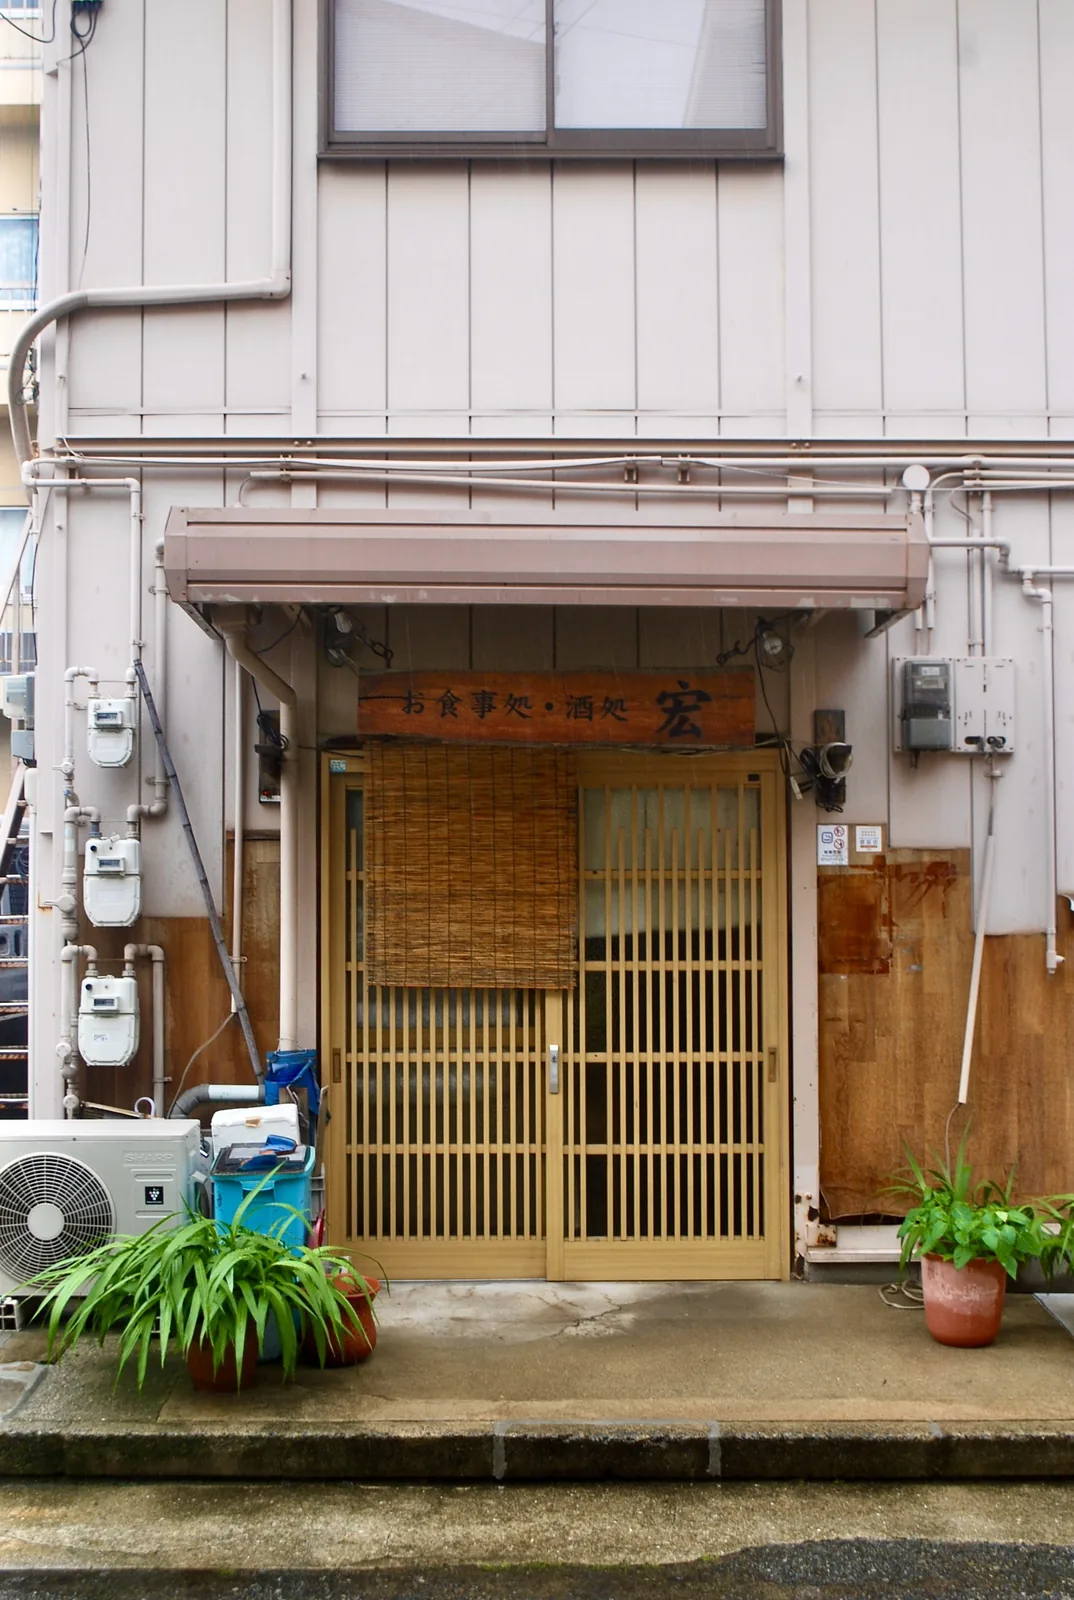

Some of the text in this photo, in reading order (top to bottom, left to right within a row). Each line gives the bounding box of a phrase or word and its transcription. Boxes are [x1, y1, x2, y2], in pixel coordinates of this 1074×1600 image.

[402, 680, 711, 738] お食事処・酒処 宏
[124, 1153, 174, 1163] SHARP
